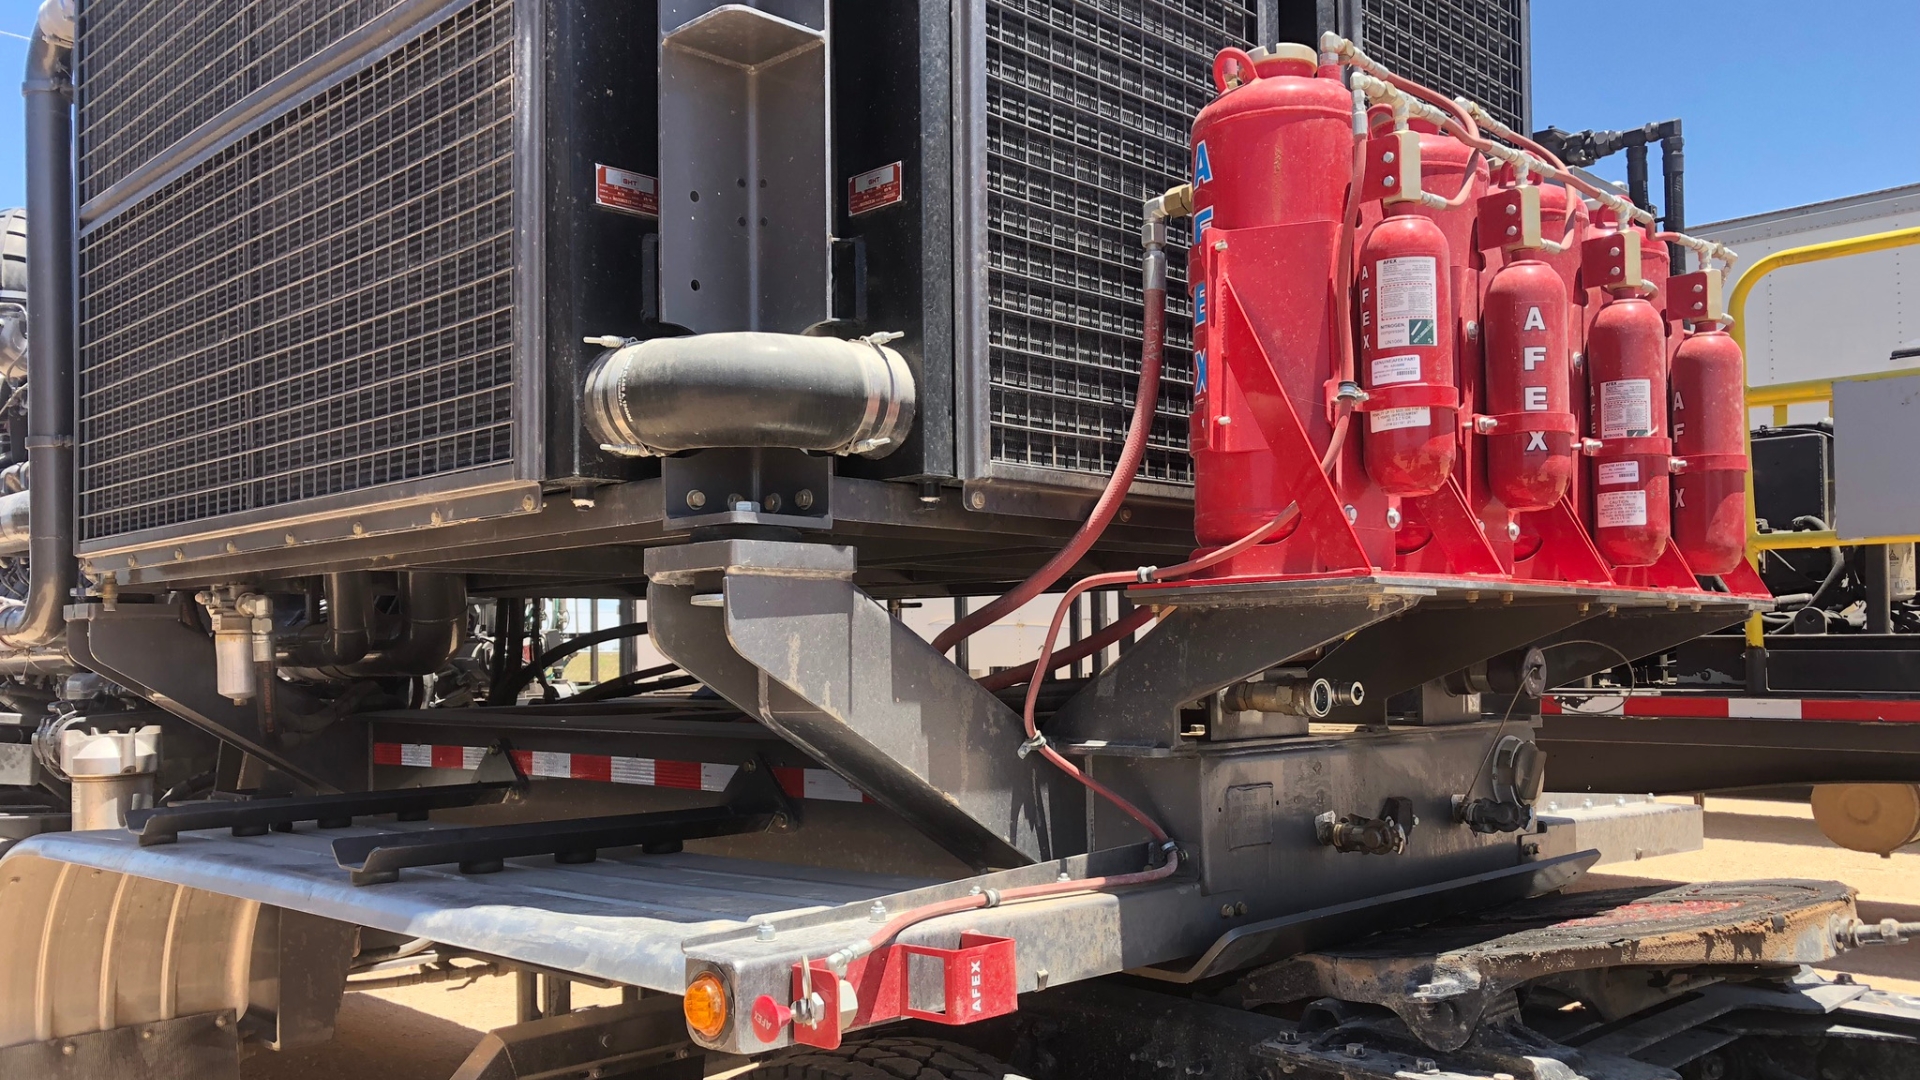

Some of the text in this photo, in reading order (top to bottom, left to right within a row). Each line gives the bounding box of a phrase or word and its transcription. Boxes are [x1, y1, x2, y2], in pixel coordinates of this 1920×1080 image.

[1362, 265, 1370, 350] AFEX
[1523, 306, 1548, 451] AFEX
[1673, 391, 1685, 508] AFX
[754, 1010, 772, 1031] AFEX
[971, 960, 981, 1012] AFEX
